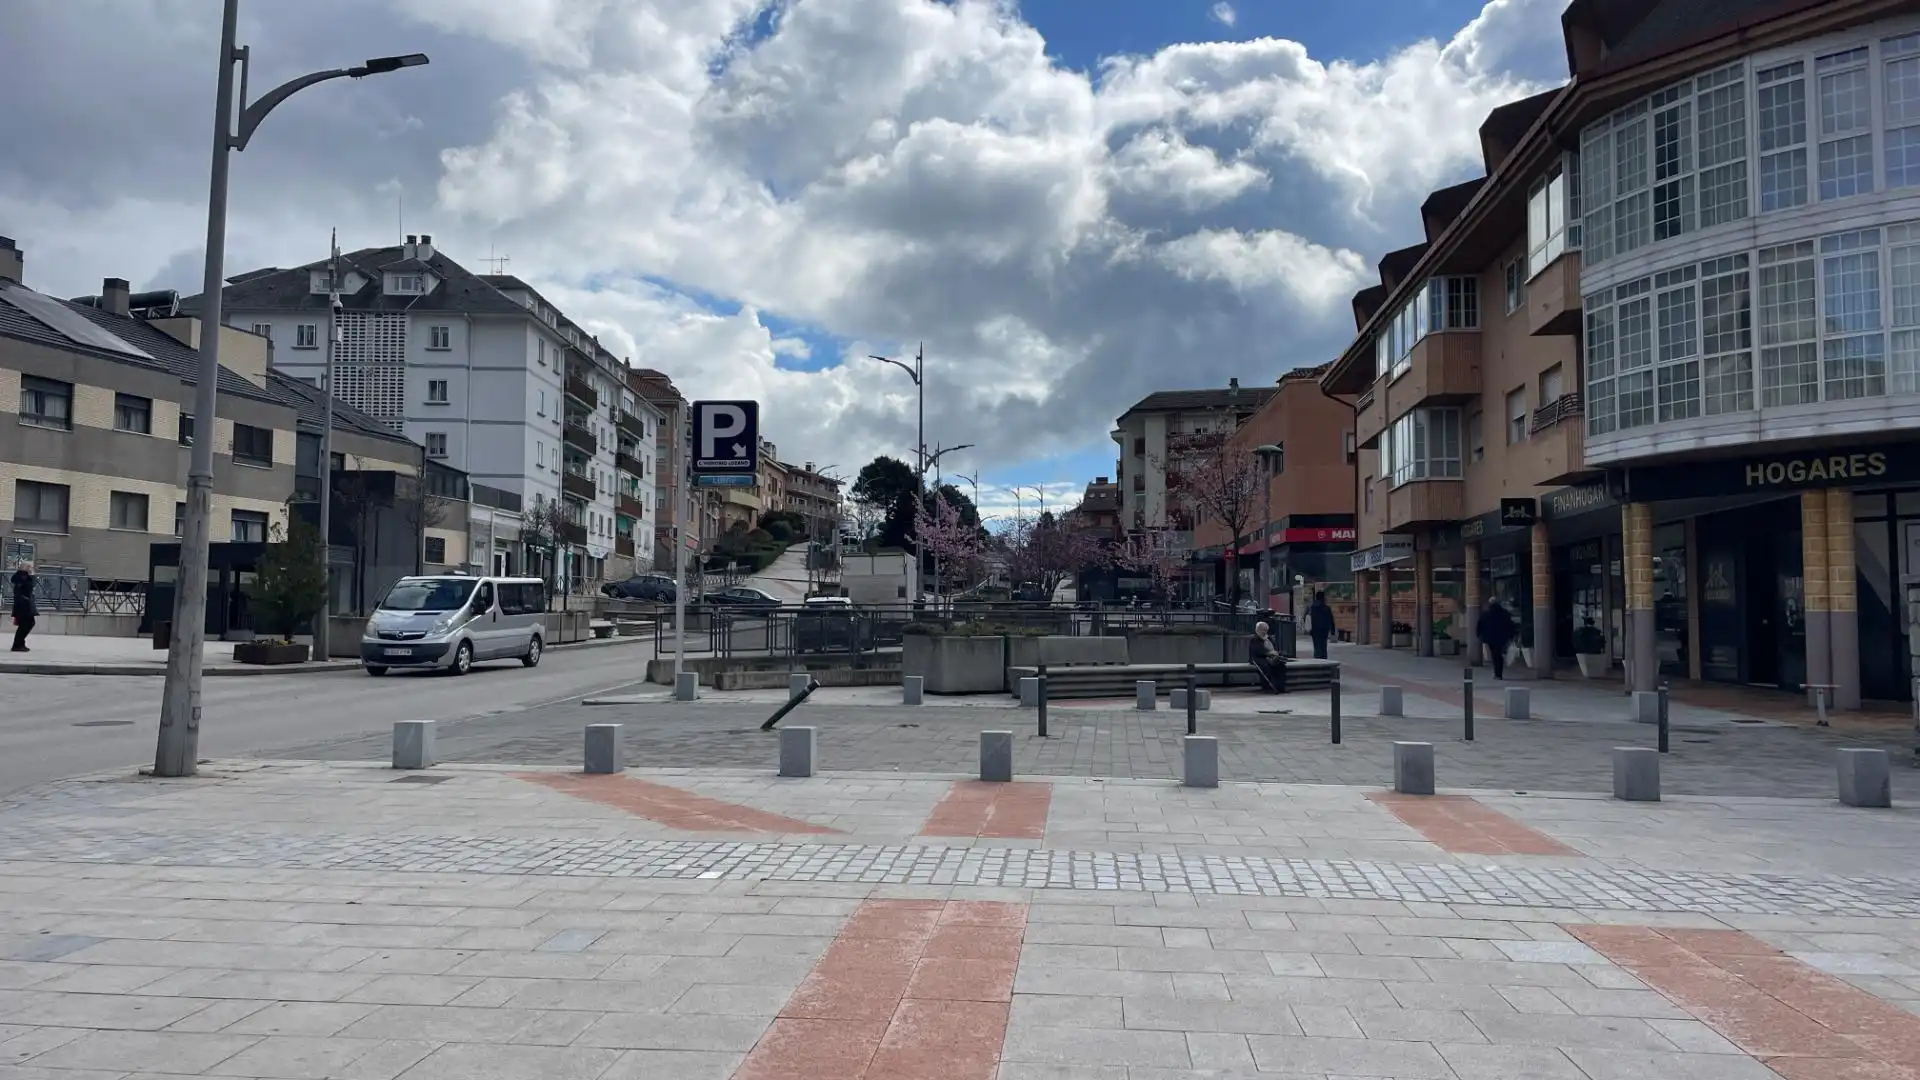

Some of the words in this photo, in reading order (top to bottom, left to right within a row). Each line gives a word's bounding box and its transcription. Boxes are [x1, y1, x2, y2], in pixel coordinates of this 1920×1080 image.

[701, 404, 746, 457] P
[1745, 453, 1886, 486] HOGARES
[1553, 484, 1604, 514] FINANHOGAR
